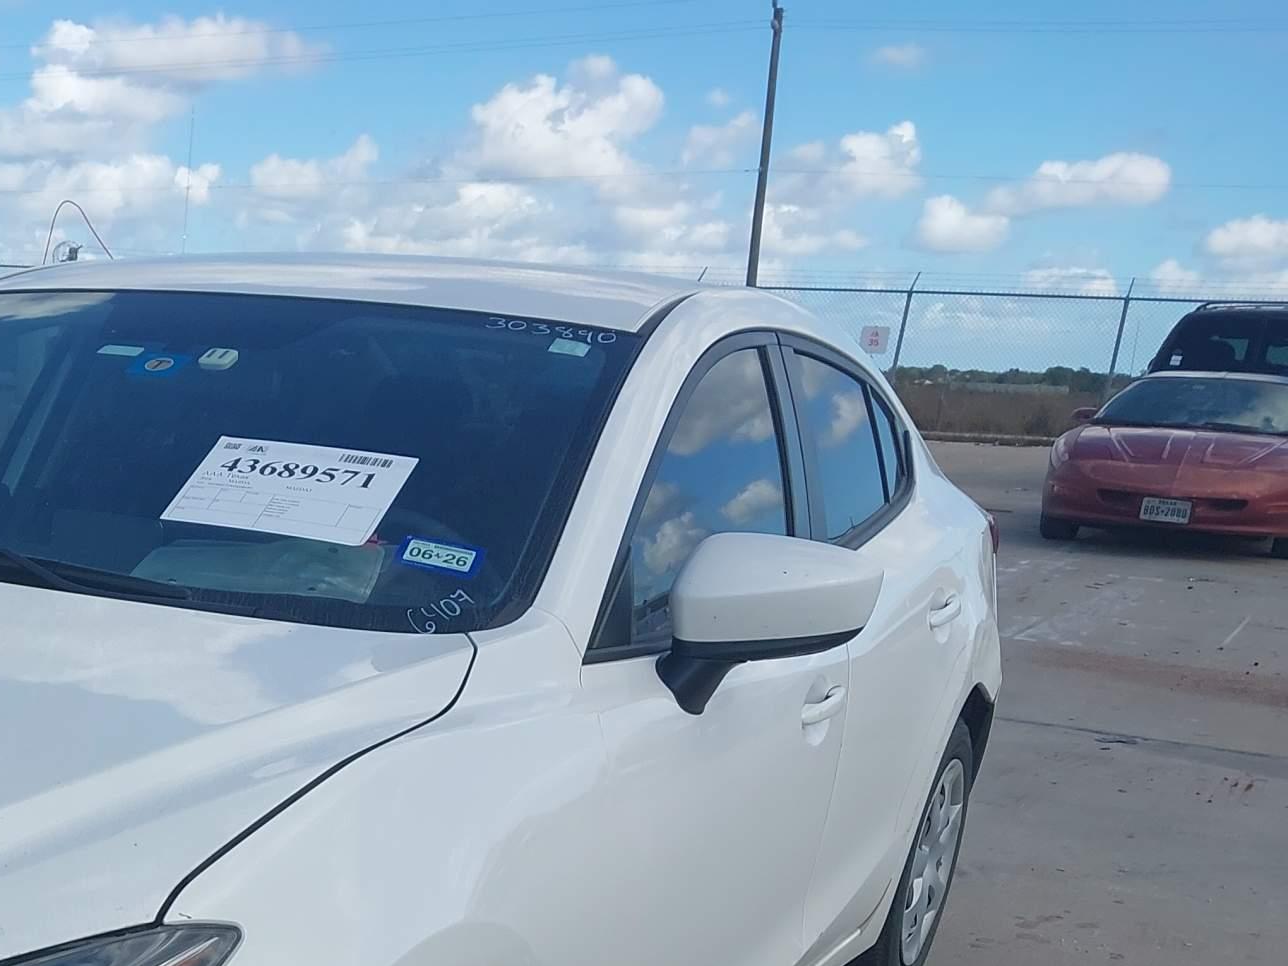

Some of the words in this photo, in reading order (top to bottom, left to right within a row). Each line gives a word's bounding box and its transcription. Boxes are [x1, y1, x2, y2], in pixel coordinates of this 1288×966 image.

[485, 316, 617, 343] 303890
[220, 456, 377, 489] 43689571
[409, 546, 433, 560] 06
[442, 553, 469, 568] 26
